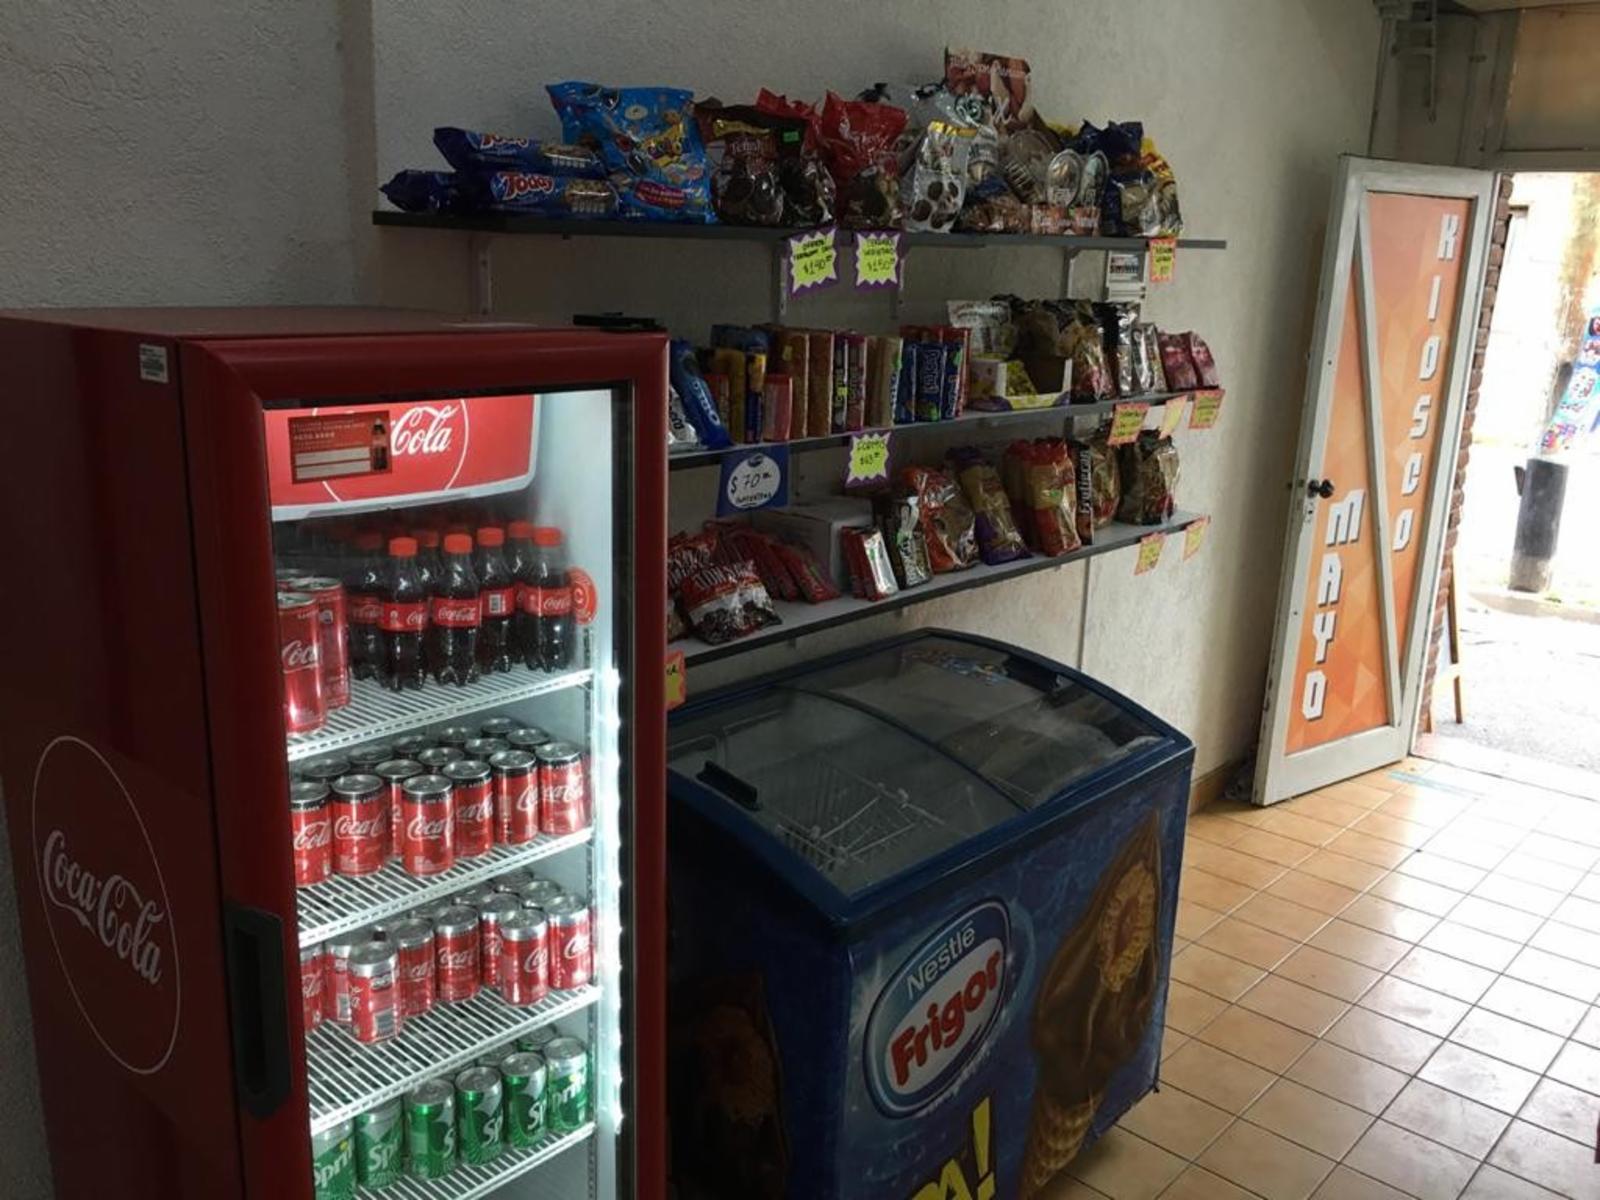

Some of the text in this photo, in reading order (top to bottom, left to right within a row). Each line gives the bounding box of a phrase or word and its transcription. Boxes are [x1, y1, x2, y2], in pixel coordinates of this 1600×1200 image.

[1301, 489, 1366, 721] MAYO
[891, 951, 1000, 1088] Frigor
[905, 919, 976, 1000] Nestlé
